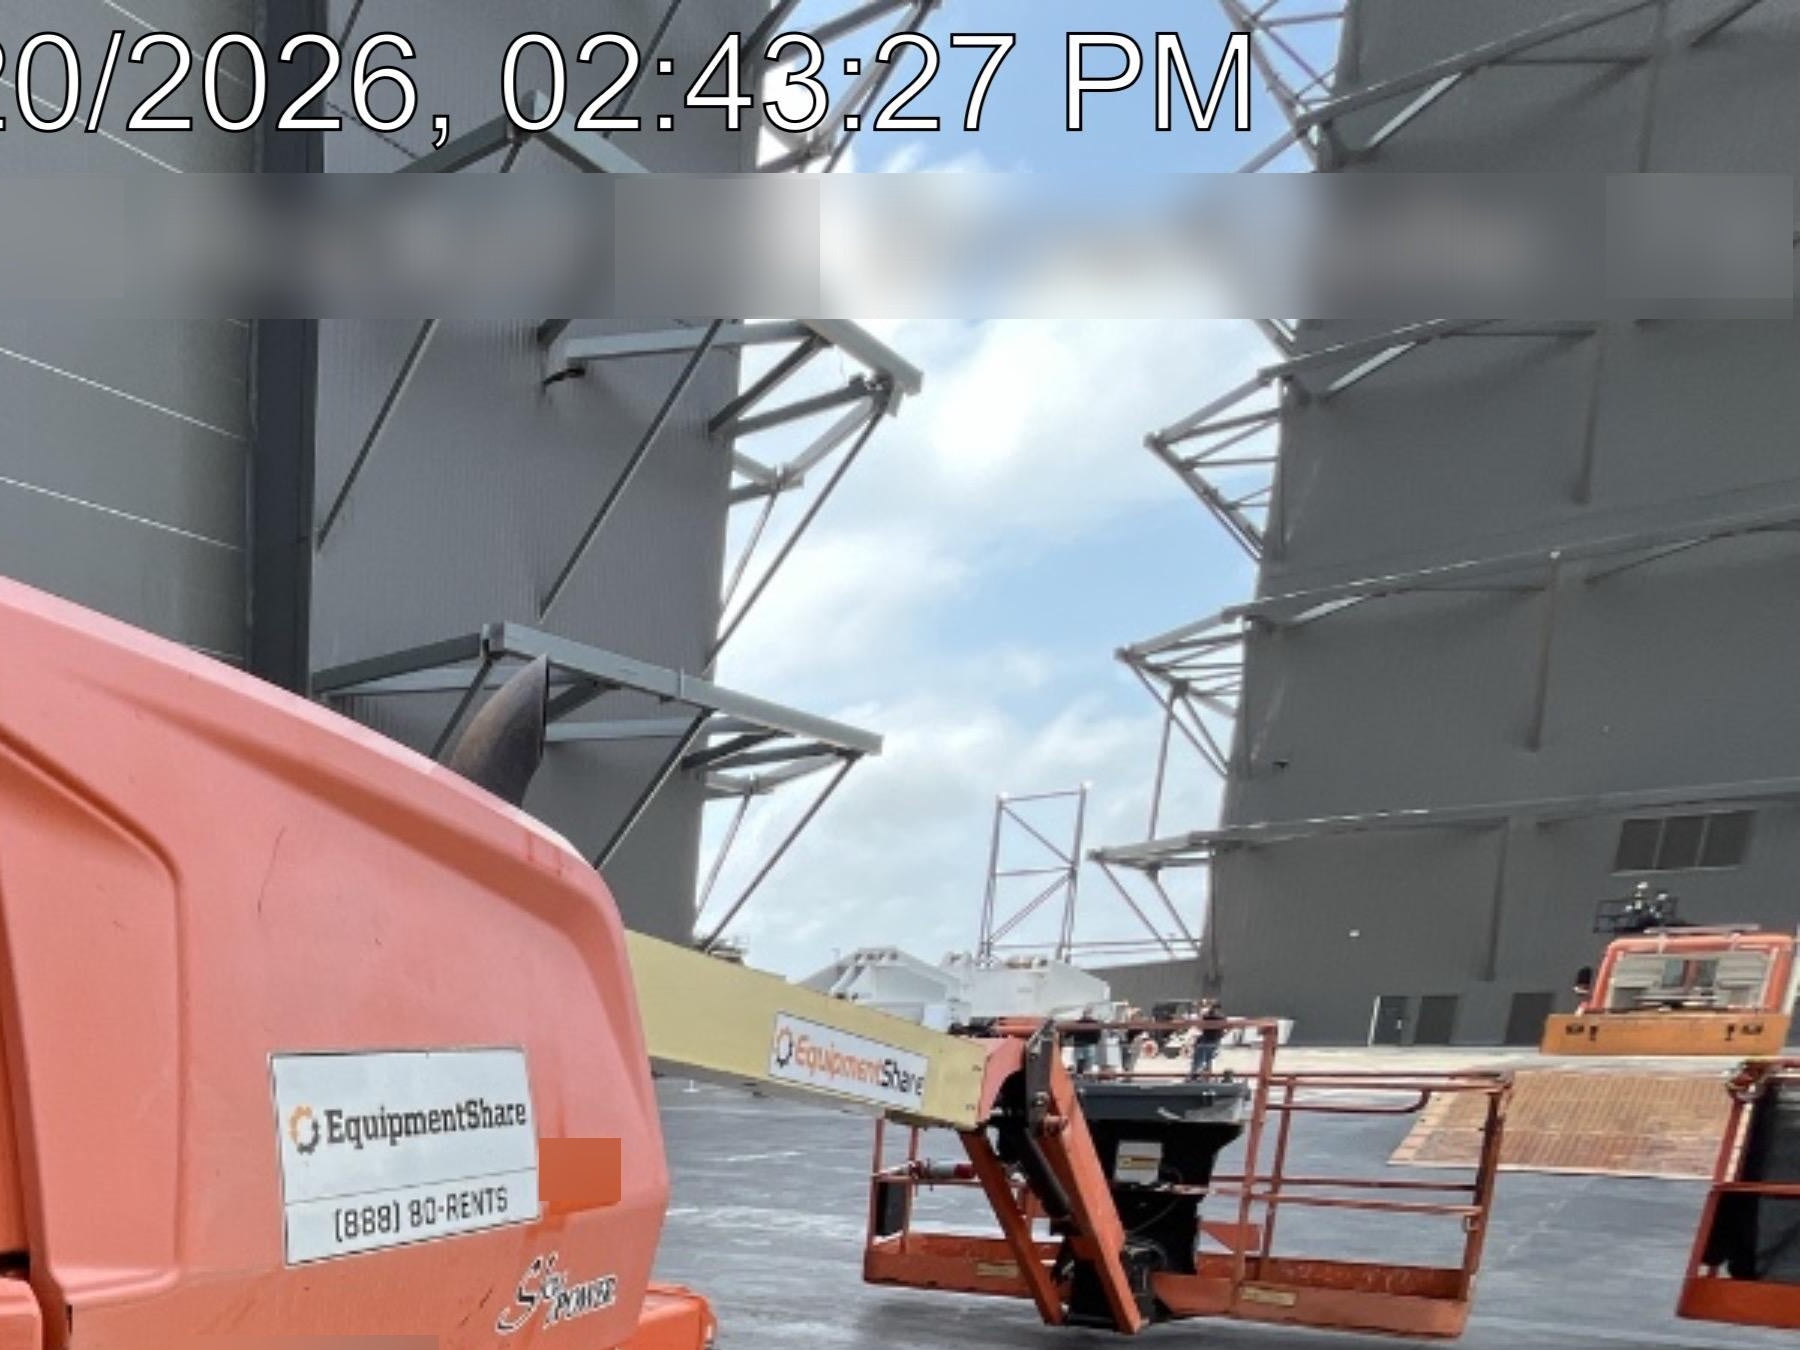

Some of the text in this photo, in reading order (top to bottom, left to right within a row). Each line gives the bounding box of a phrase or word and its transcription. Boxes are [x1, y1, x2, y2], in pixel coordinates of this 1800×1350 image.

[793, 1033, 926, 1096] EquipmentShare
[324, 1098, 527, 1149] EquipmentShare
[334, 1186, 509, 1243] (888) 80-RENTS
